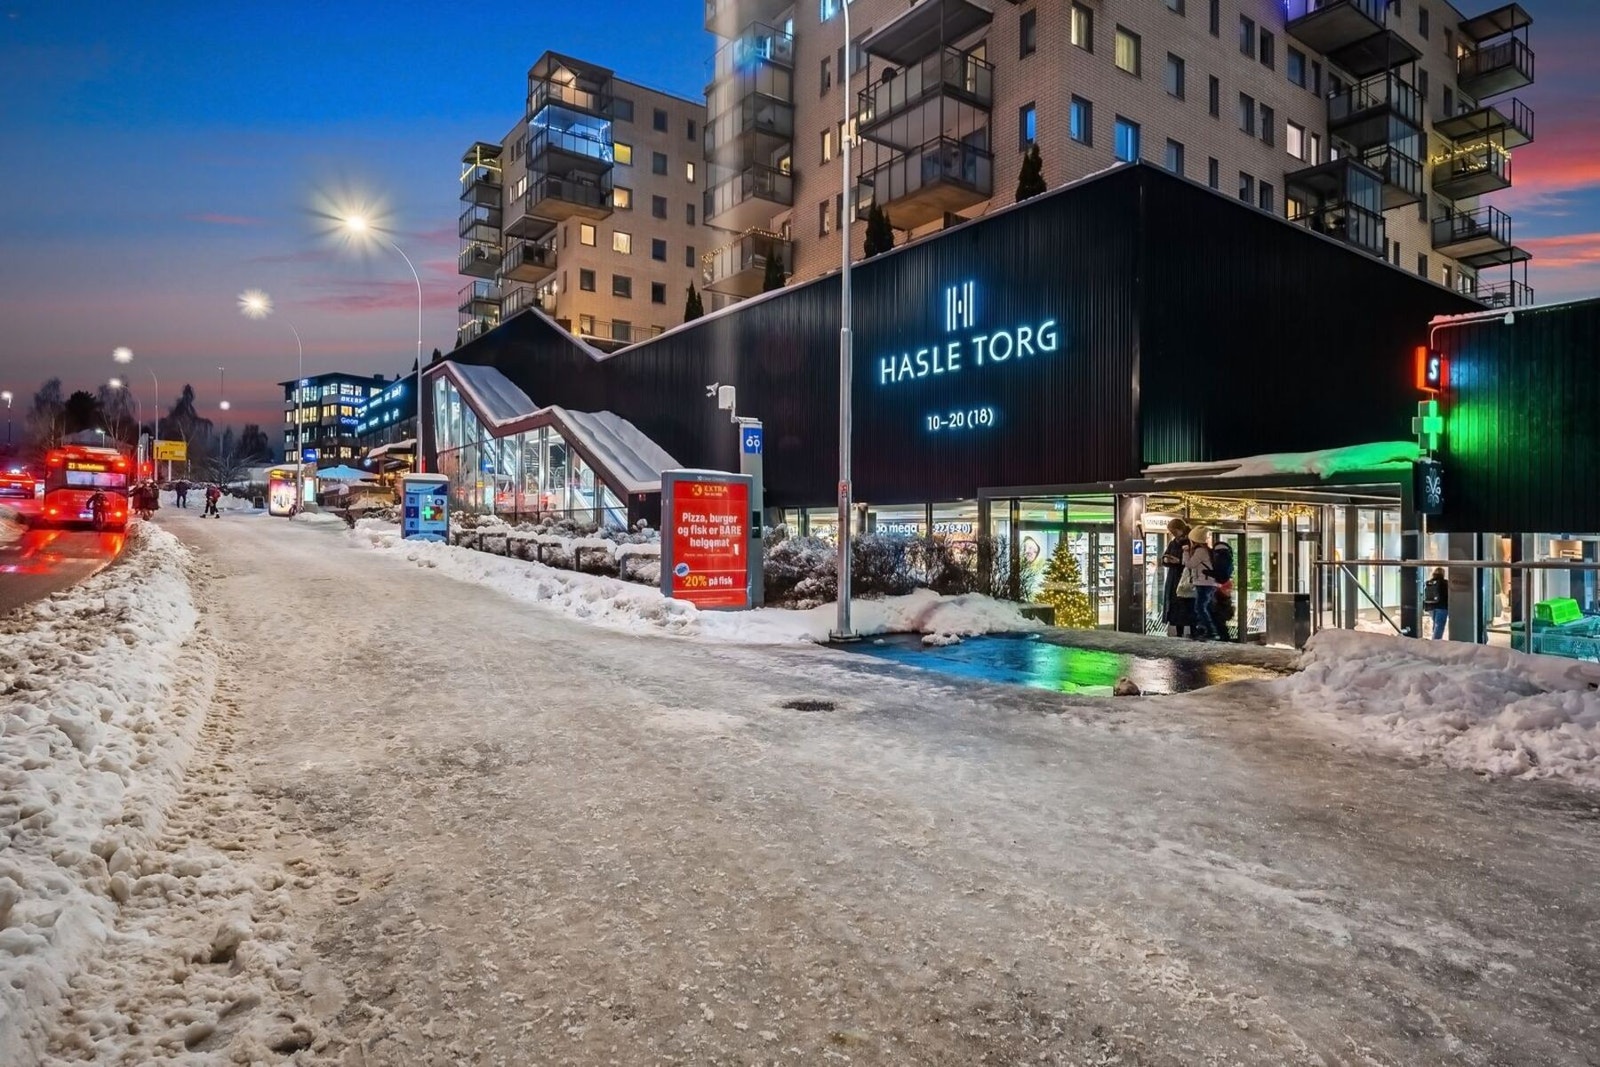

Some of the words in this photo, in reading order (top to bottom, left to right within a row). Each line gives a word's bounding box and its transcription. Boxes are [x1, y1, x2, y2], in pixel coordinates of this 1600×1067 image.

[881, 342, 961, 385] HASLE
[972, 320, 1058, 366] TORG
[966, 407, 994, 429] (18)
[682, 512, 708, 525] Pizza,
[709, 513, 738, 525] burger
[677, 527, 689, 537] og
[690, 525, 708, 535] fisk
[708, 527, 718, 535] er
[719, 526, 742, 535] BARE
[889, 524, 917, 537] mega
[708, 576, 718, 587] på
[718, 576, 733, 586] fisk
